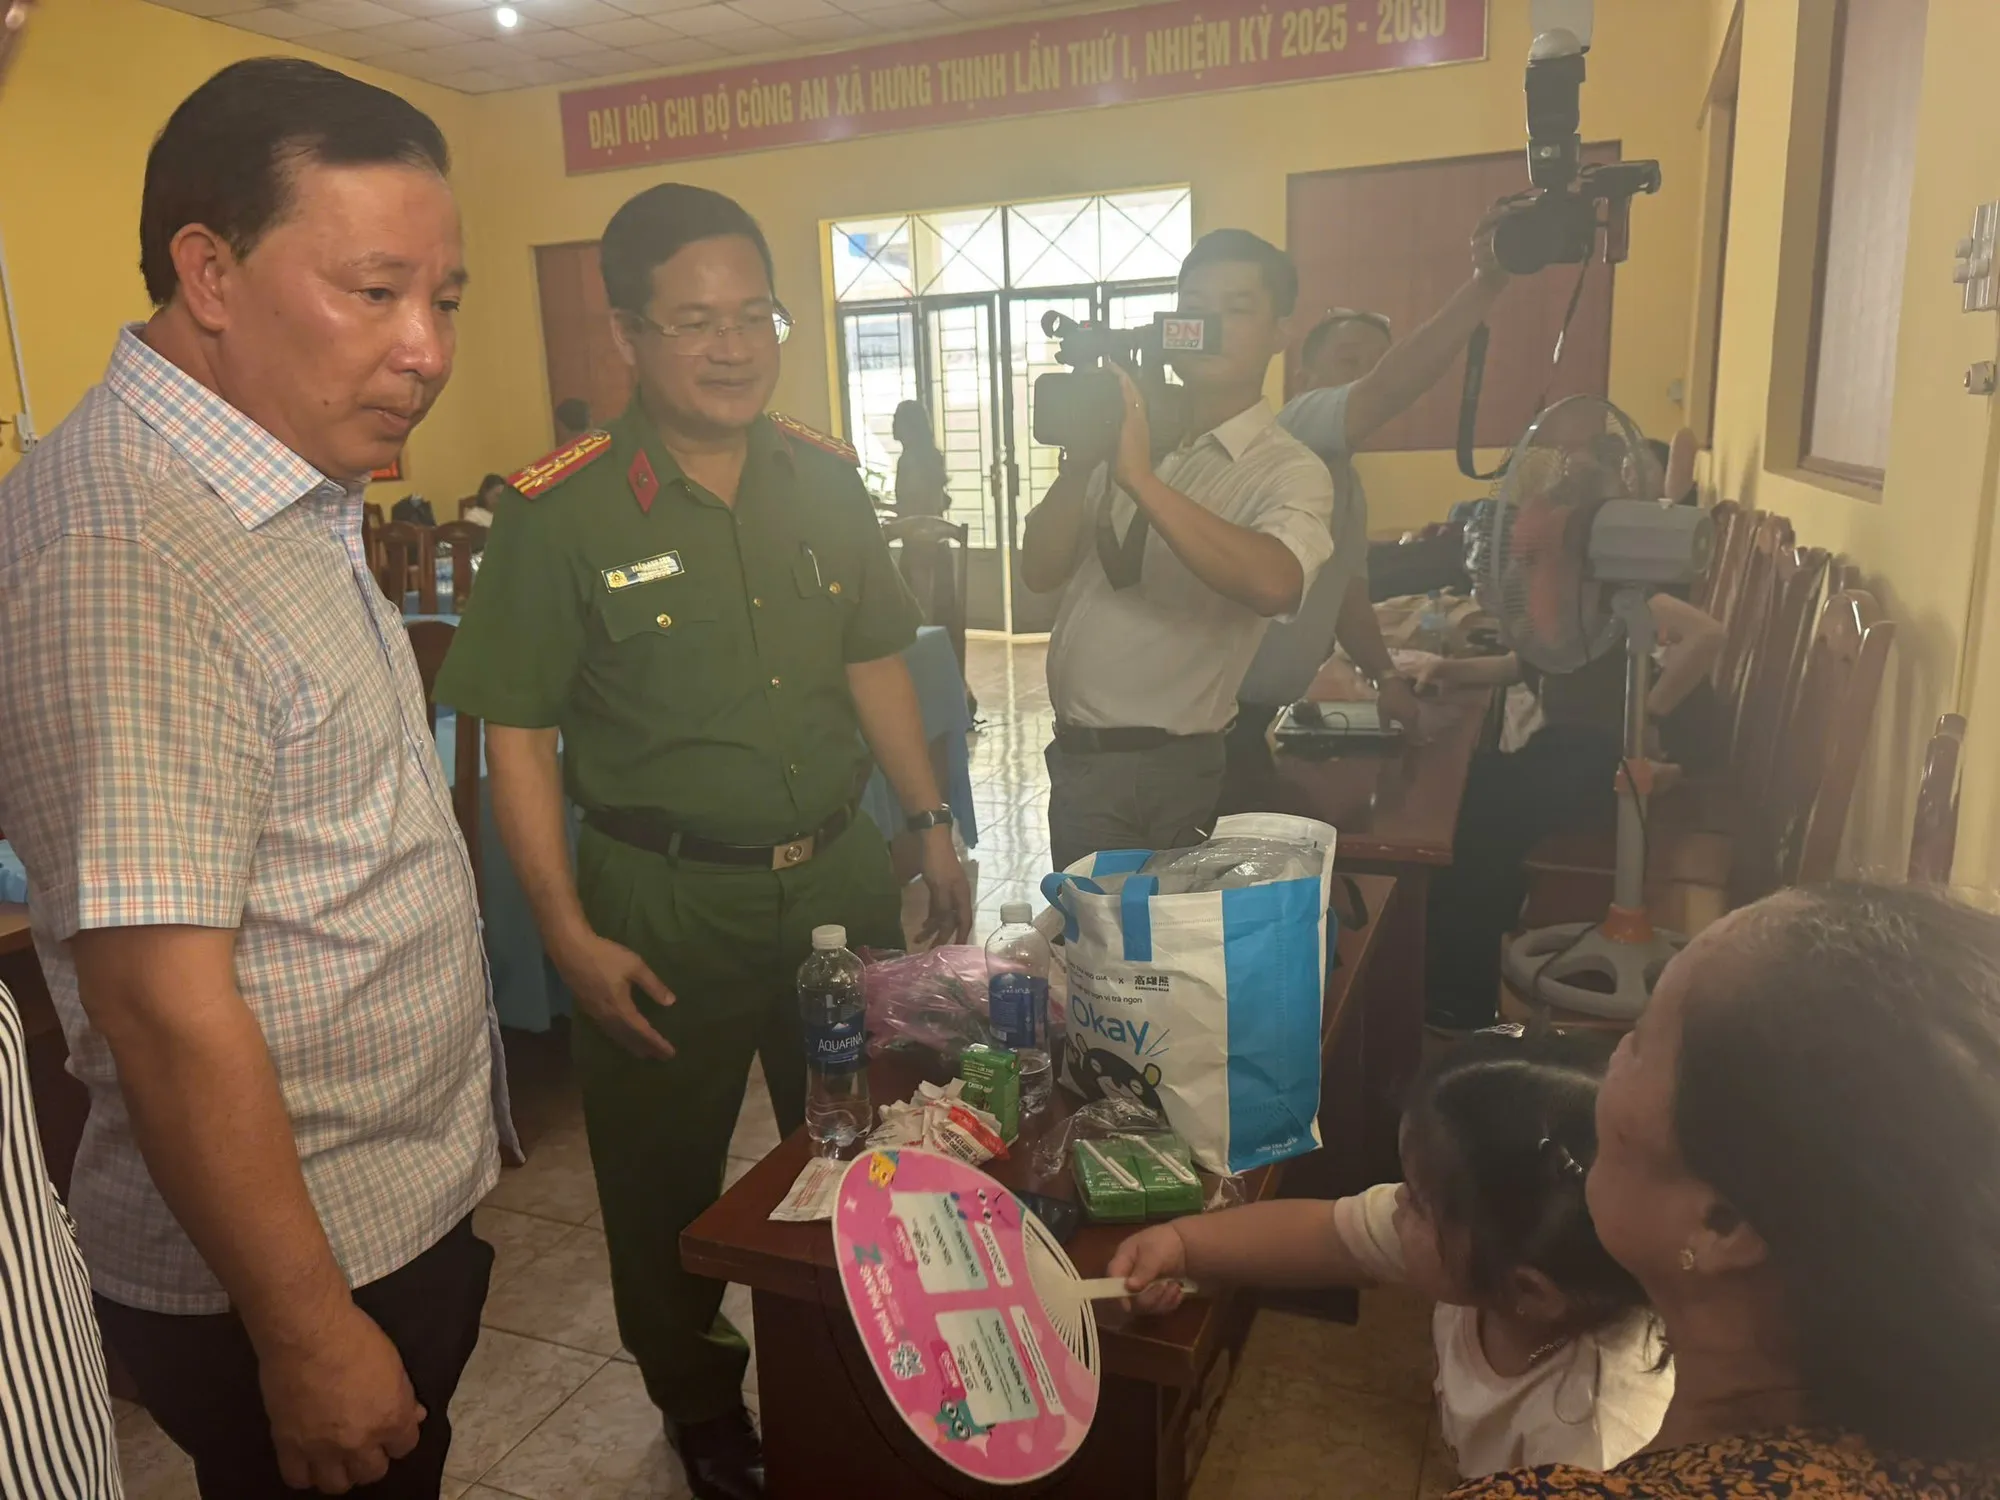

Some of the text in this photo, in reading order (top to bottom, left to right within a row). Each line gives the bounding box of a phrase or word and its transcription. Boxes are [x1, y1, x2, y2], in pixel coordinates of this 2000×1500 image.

[588, 0, 1447, 156] ĐẠI HỘI CHI BỘ CÔNG AN XÃ HƯNG THỊNH LẦN THỨ I, NHIỆM KỲ 2025 - 2030
[1123, 997, 1142, 1005] ngon
[817, 1031, 864, 1053] AQUAFINA
[1072, 994, 1150, 1056] Okay
